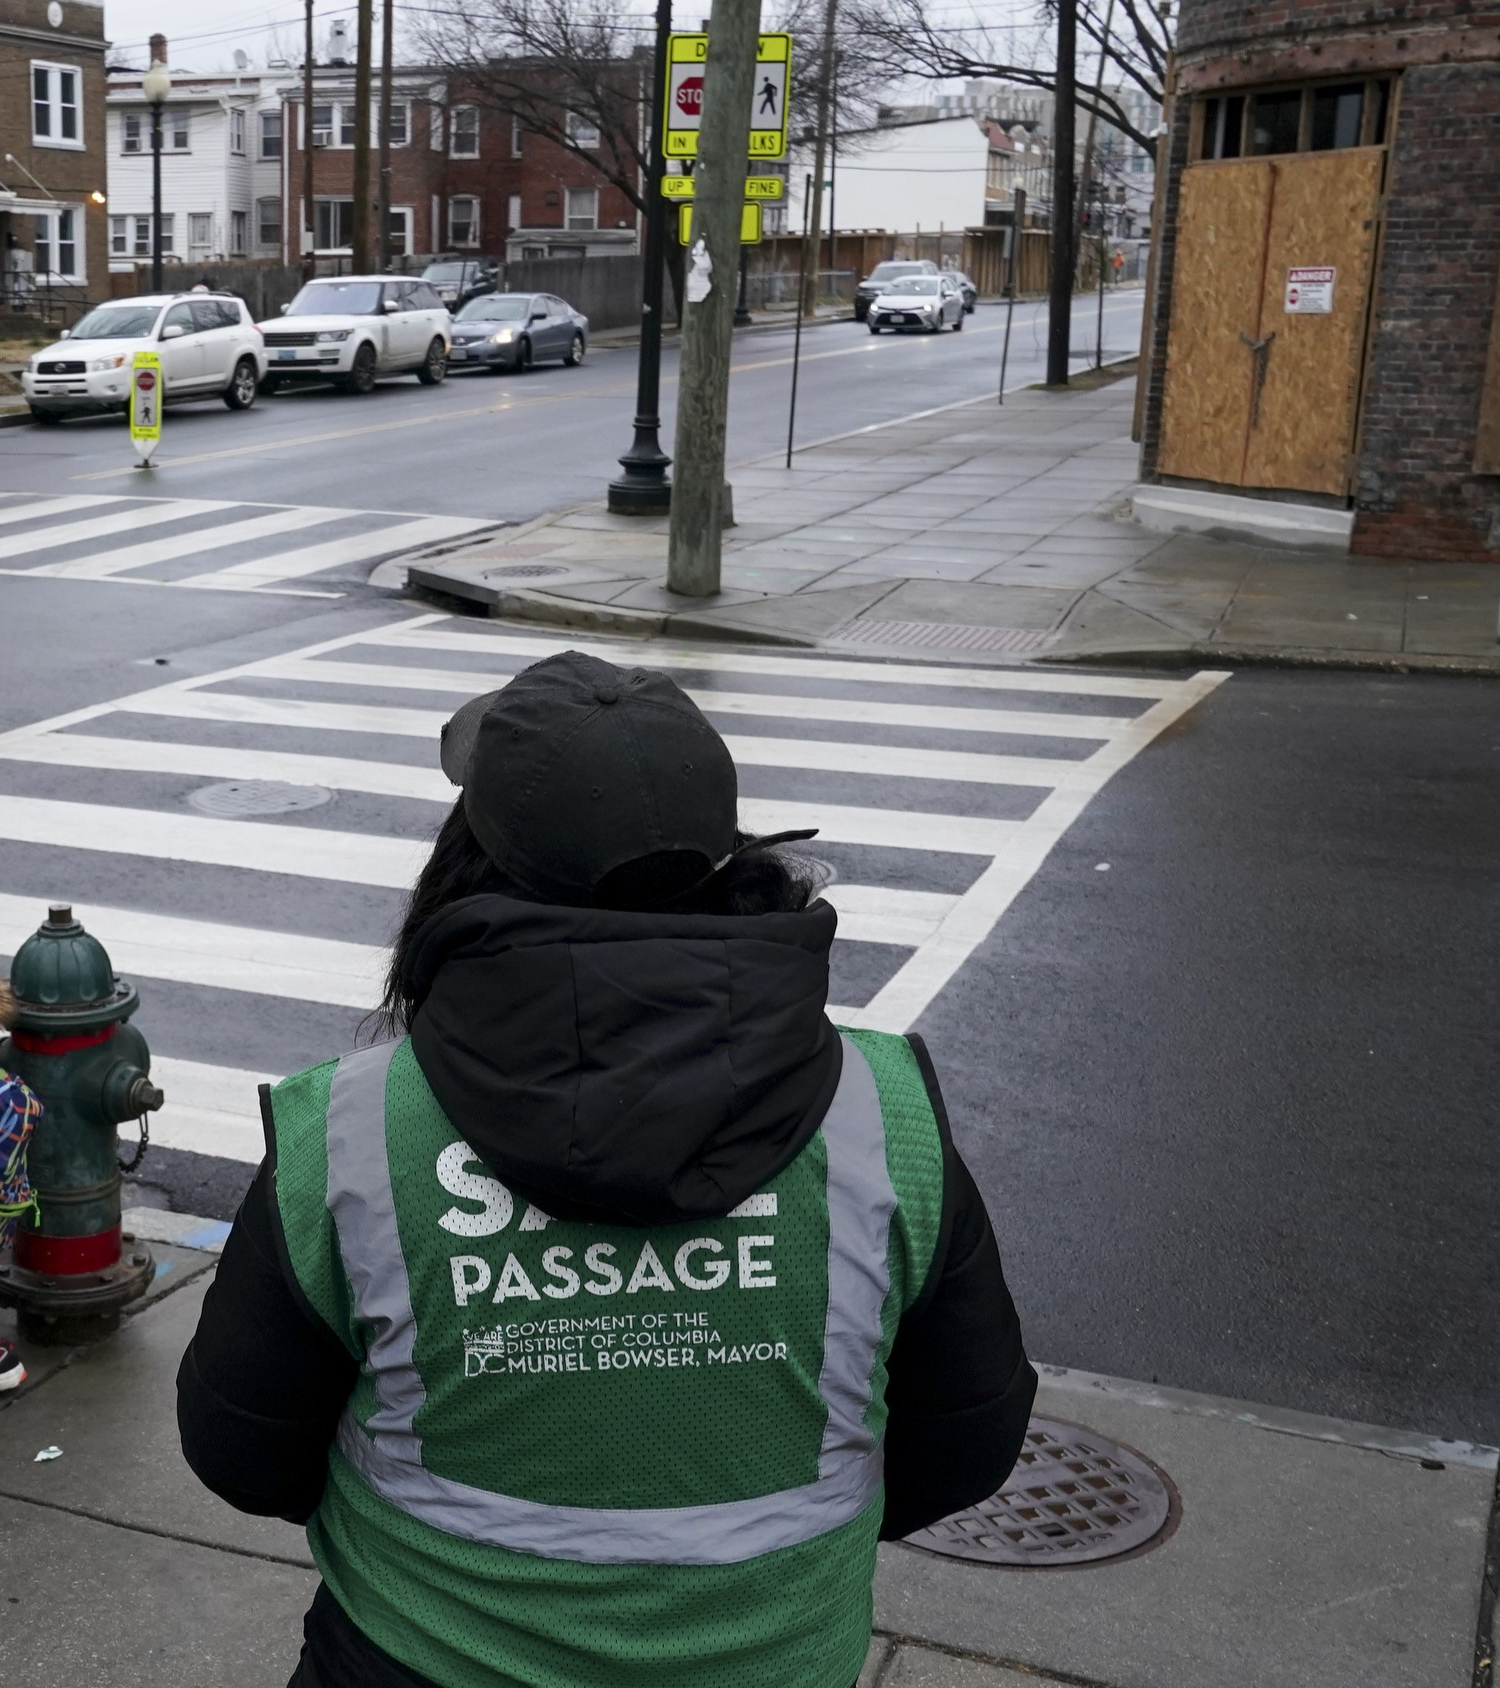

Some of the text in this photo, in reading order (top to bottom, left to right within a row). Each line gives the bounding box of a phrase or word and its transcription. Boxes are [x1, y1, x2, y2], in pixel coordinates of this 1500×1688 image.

[677, 88, 704, 103] STO
[673, 137, 686, 148] IN
[667, 181, 684, 191] UP
[748, 181, 776, 193] FINE
[1298, 271, 1331, 281] DANGER
[449, 1235, 777, 1306] PASSAGE
[505, 1311, 710, 1339] GOVERNMENT OF THE
[483, 1329, 505, 1340] ARE
[506, 1334, 586, 1354] DISTRICT
[590, 1333, 618, 1350] OF
[621, 1329, 722, 1348] COLUMBIA
[507, 1341, 789, 1375] MURIEL BOWSER, MAYOR
